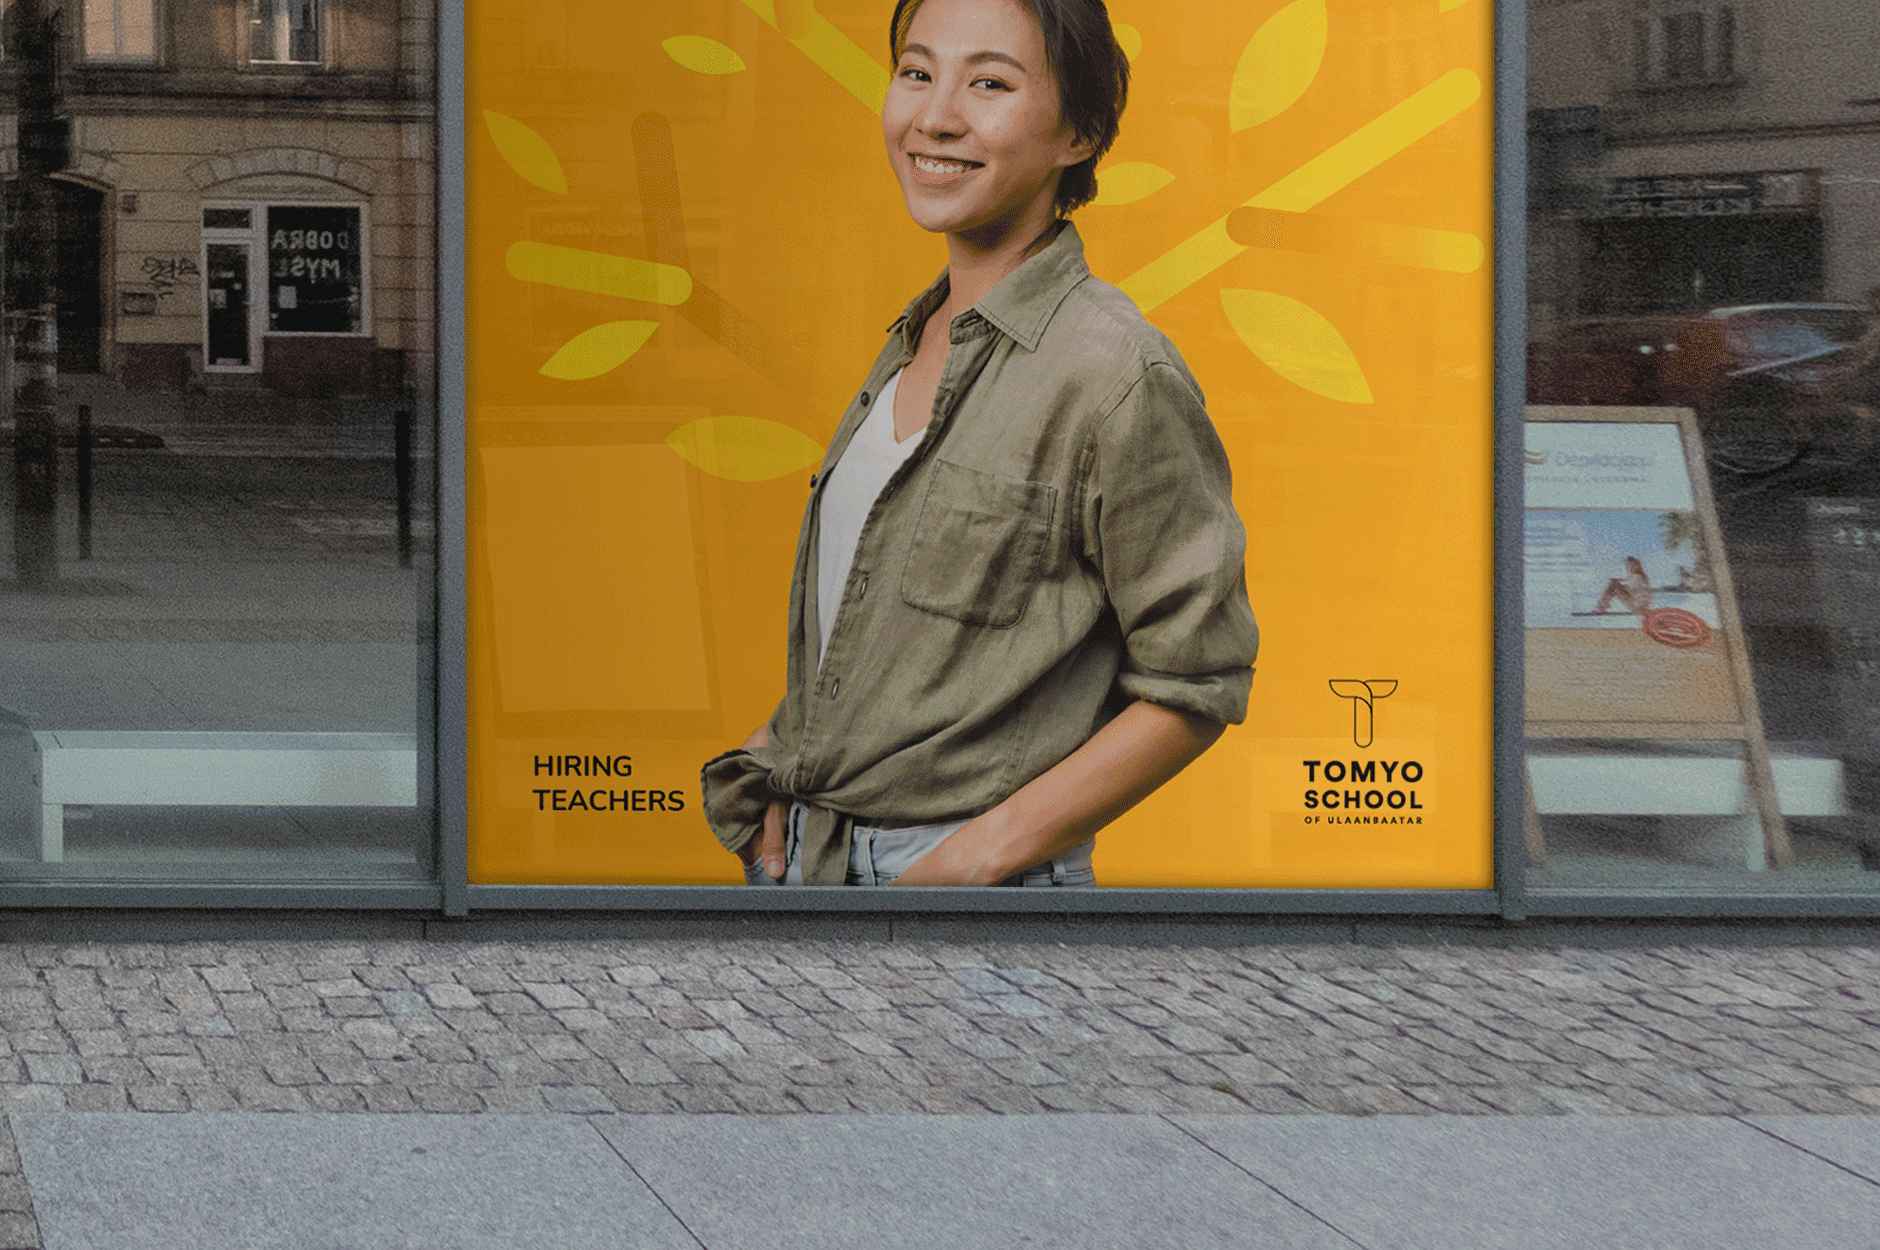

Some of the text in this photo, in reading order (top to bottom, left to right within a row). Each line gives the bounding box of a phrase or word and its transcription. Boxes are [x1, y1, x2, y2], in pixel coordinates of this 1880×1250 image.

[534, 754, 633, 778] HIRING
[1302, 760, 1423, 783] TOMYO
[531, 789, 686, 812] TEACHERS
[1304, 789, 1423, 810] SCHOOL
[1304, 816, 1423, 825] OF ULAANBAATAR
